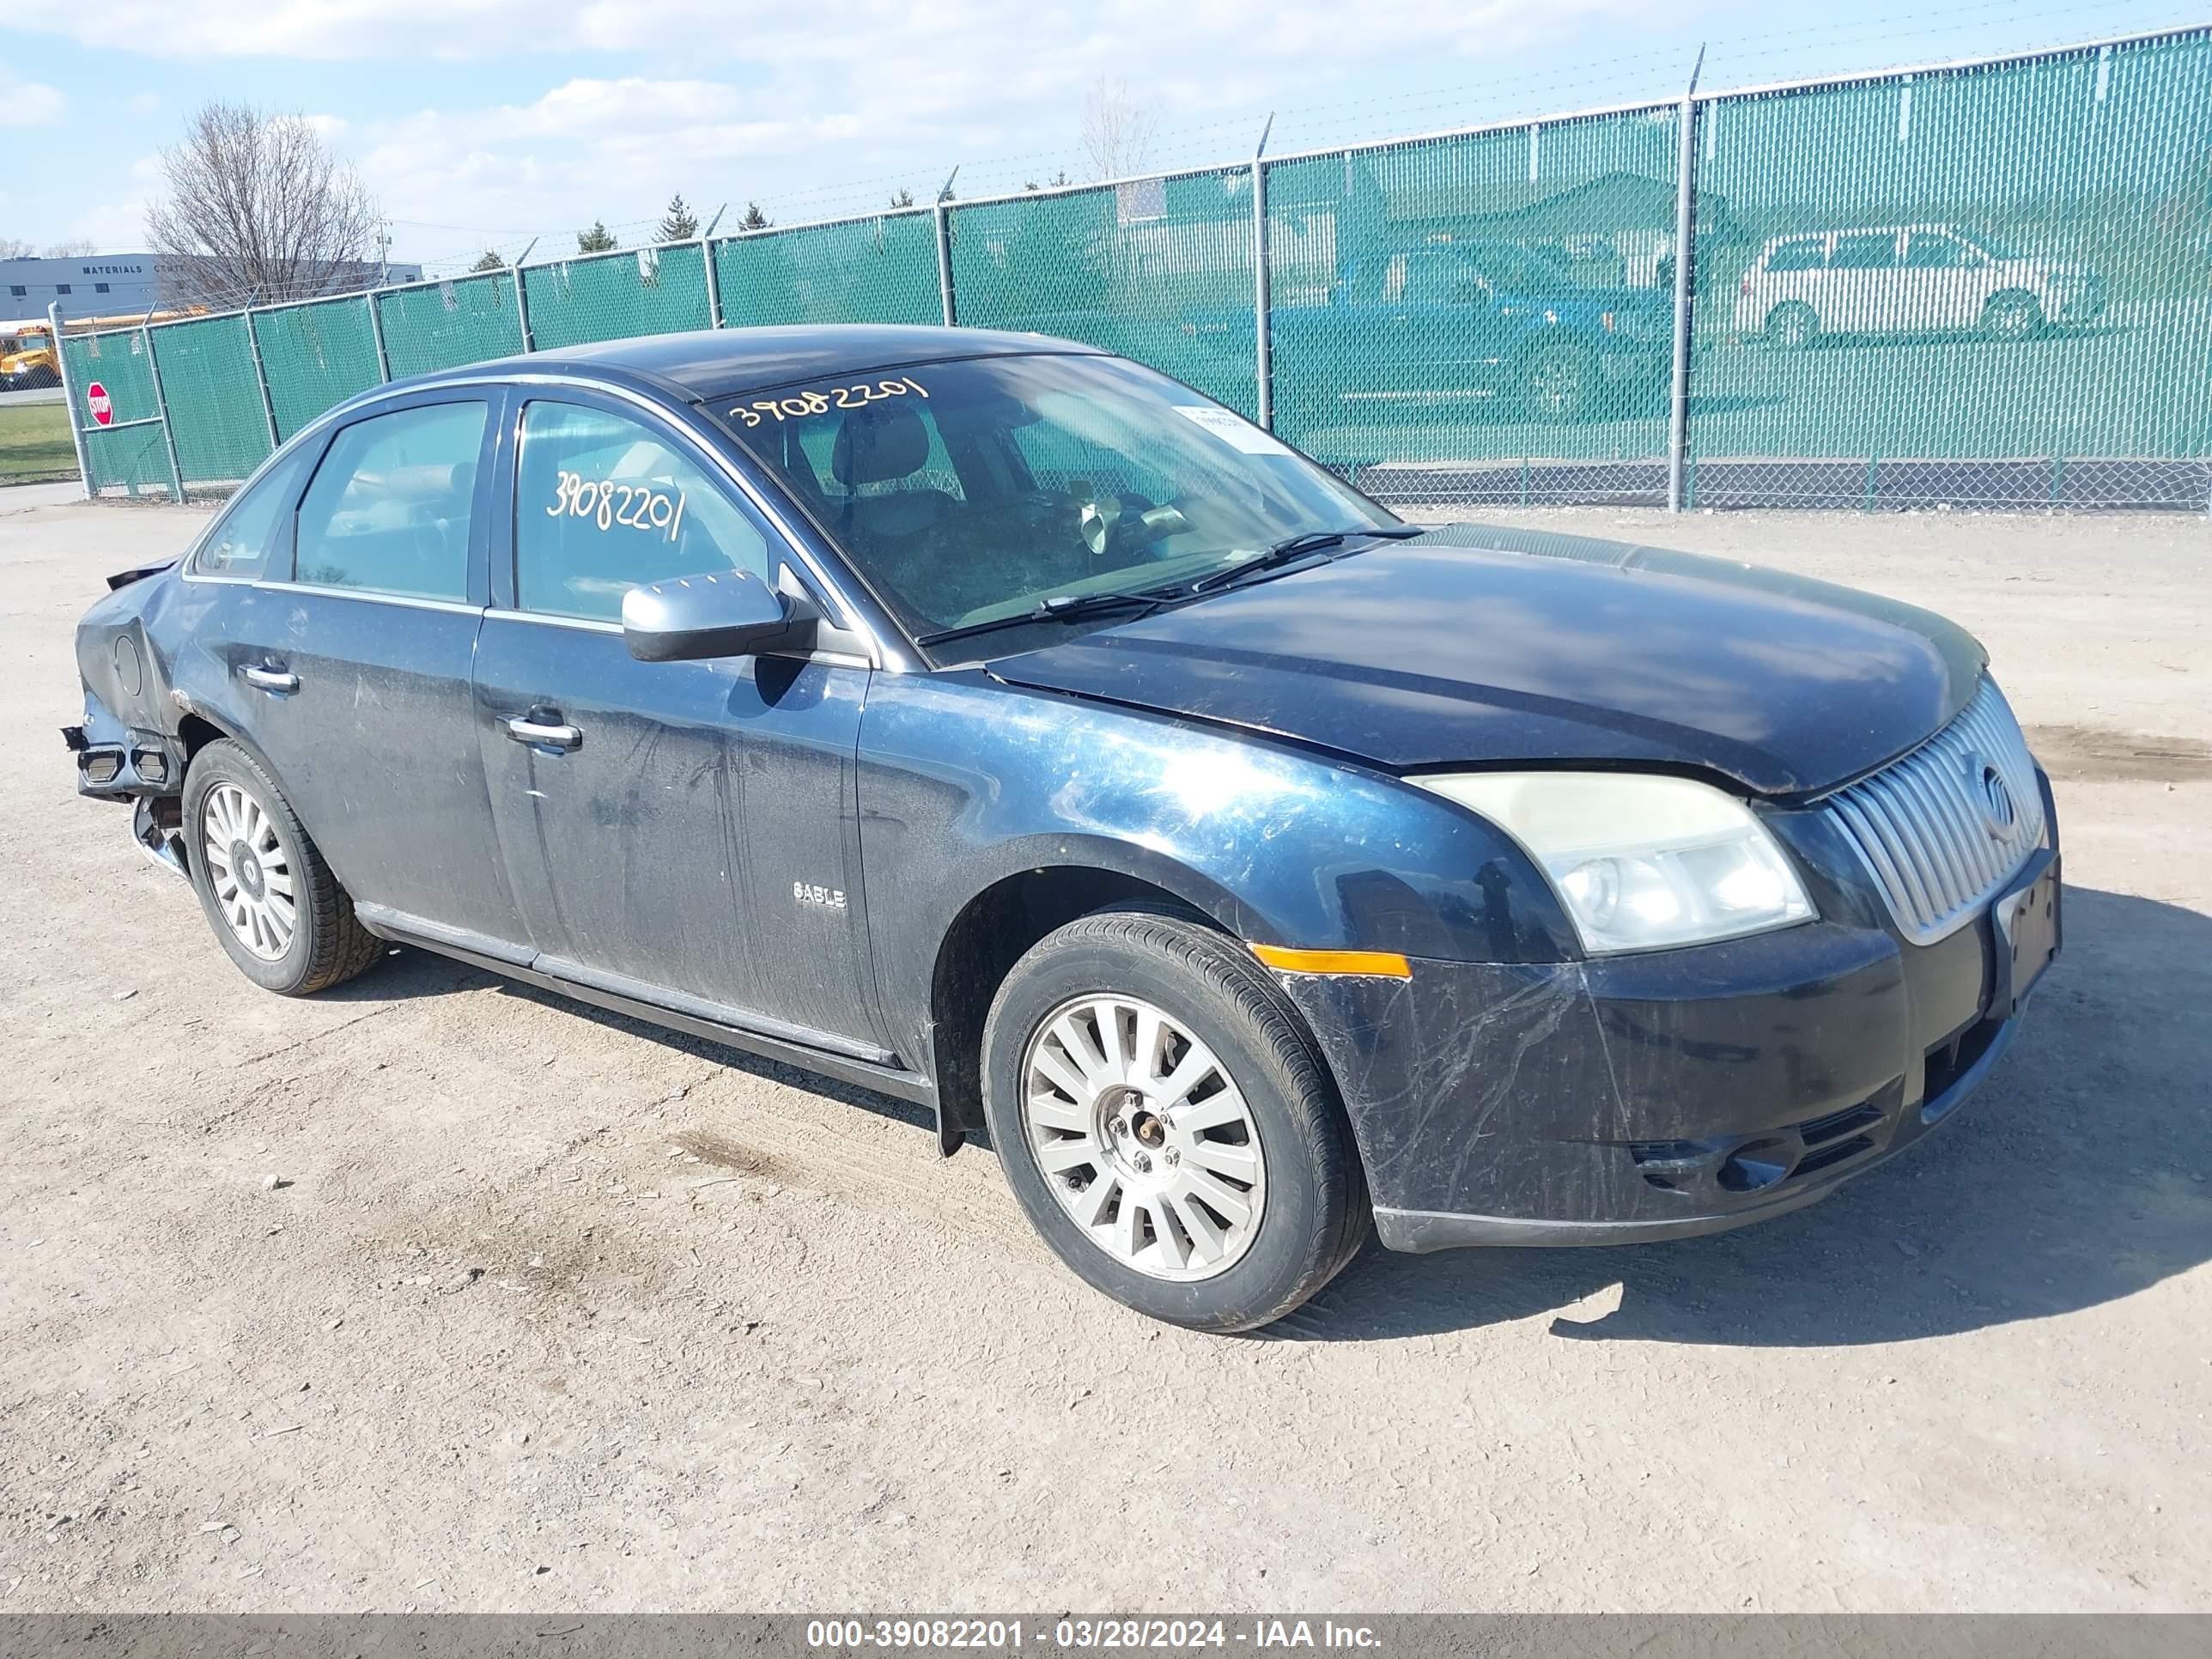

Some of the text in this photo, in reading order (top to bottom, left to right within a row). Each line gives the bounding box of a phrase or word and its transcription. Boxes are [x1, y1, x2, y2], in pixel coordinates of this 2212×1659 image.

[82, 265, 143, 275] MATERIALS
[89, 396, 109, 414] STOP
[728, 376, 930, 428] 39082201
[545, 470, 687, 543] 39082201
[793, 881, 847, 908] SABLE
